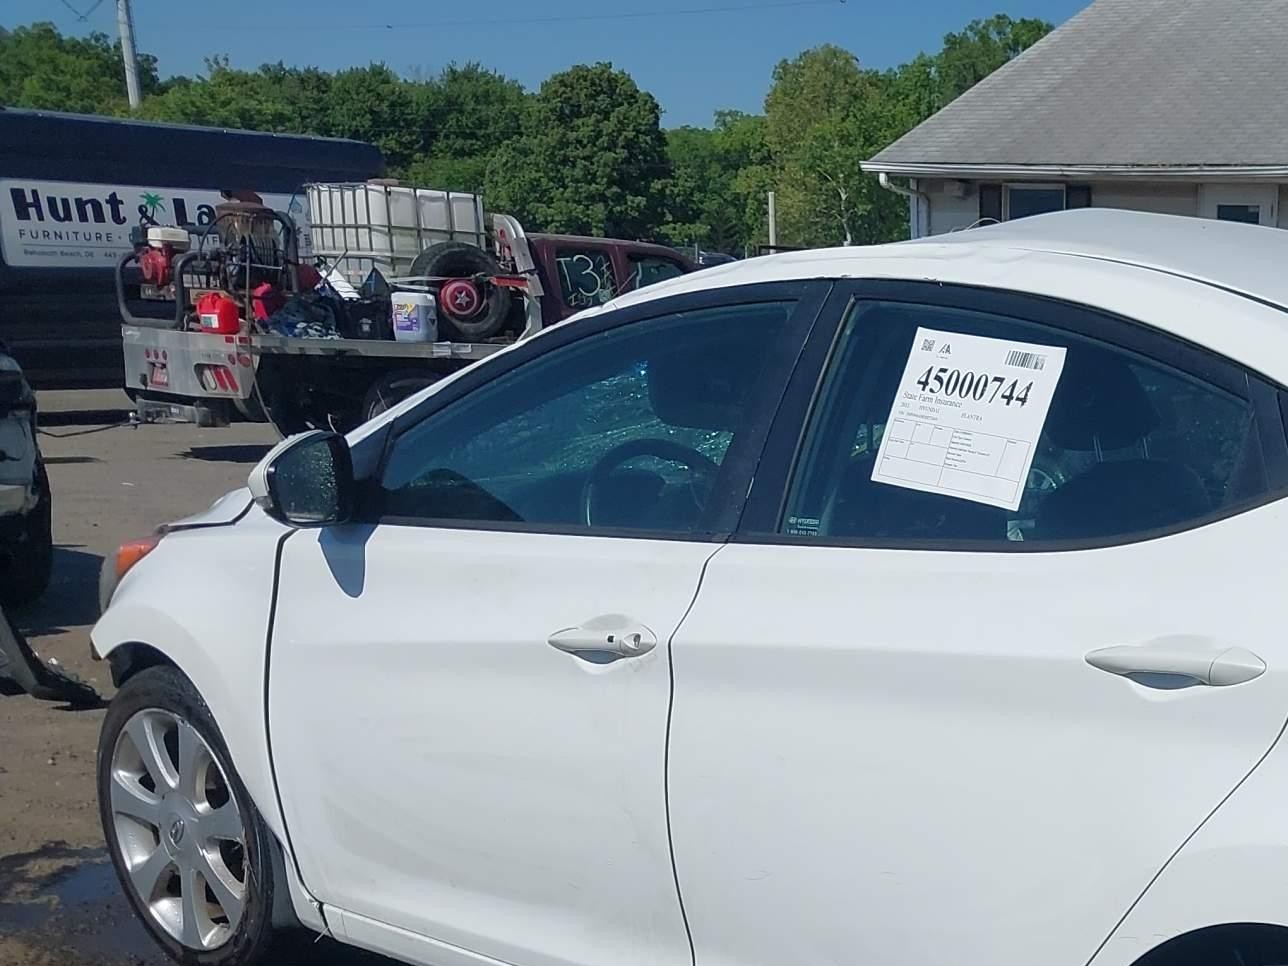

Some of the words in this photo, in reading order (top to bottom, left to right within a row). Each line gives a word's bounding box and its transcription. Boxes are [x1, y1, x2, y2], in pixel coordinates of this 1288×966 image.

[10, 187, 127, 225] Hunt
[172, 198, 217, 227] La
[19, 229, 113, 242] FURNITURE
[903, 391, 918, 401] State
[919, 393, 934, 404] Farm
[935, 396, 962, 408] Insurance
[917, 366, 1034, 409] 45000744
